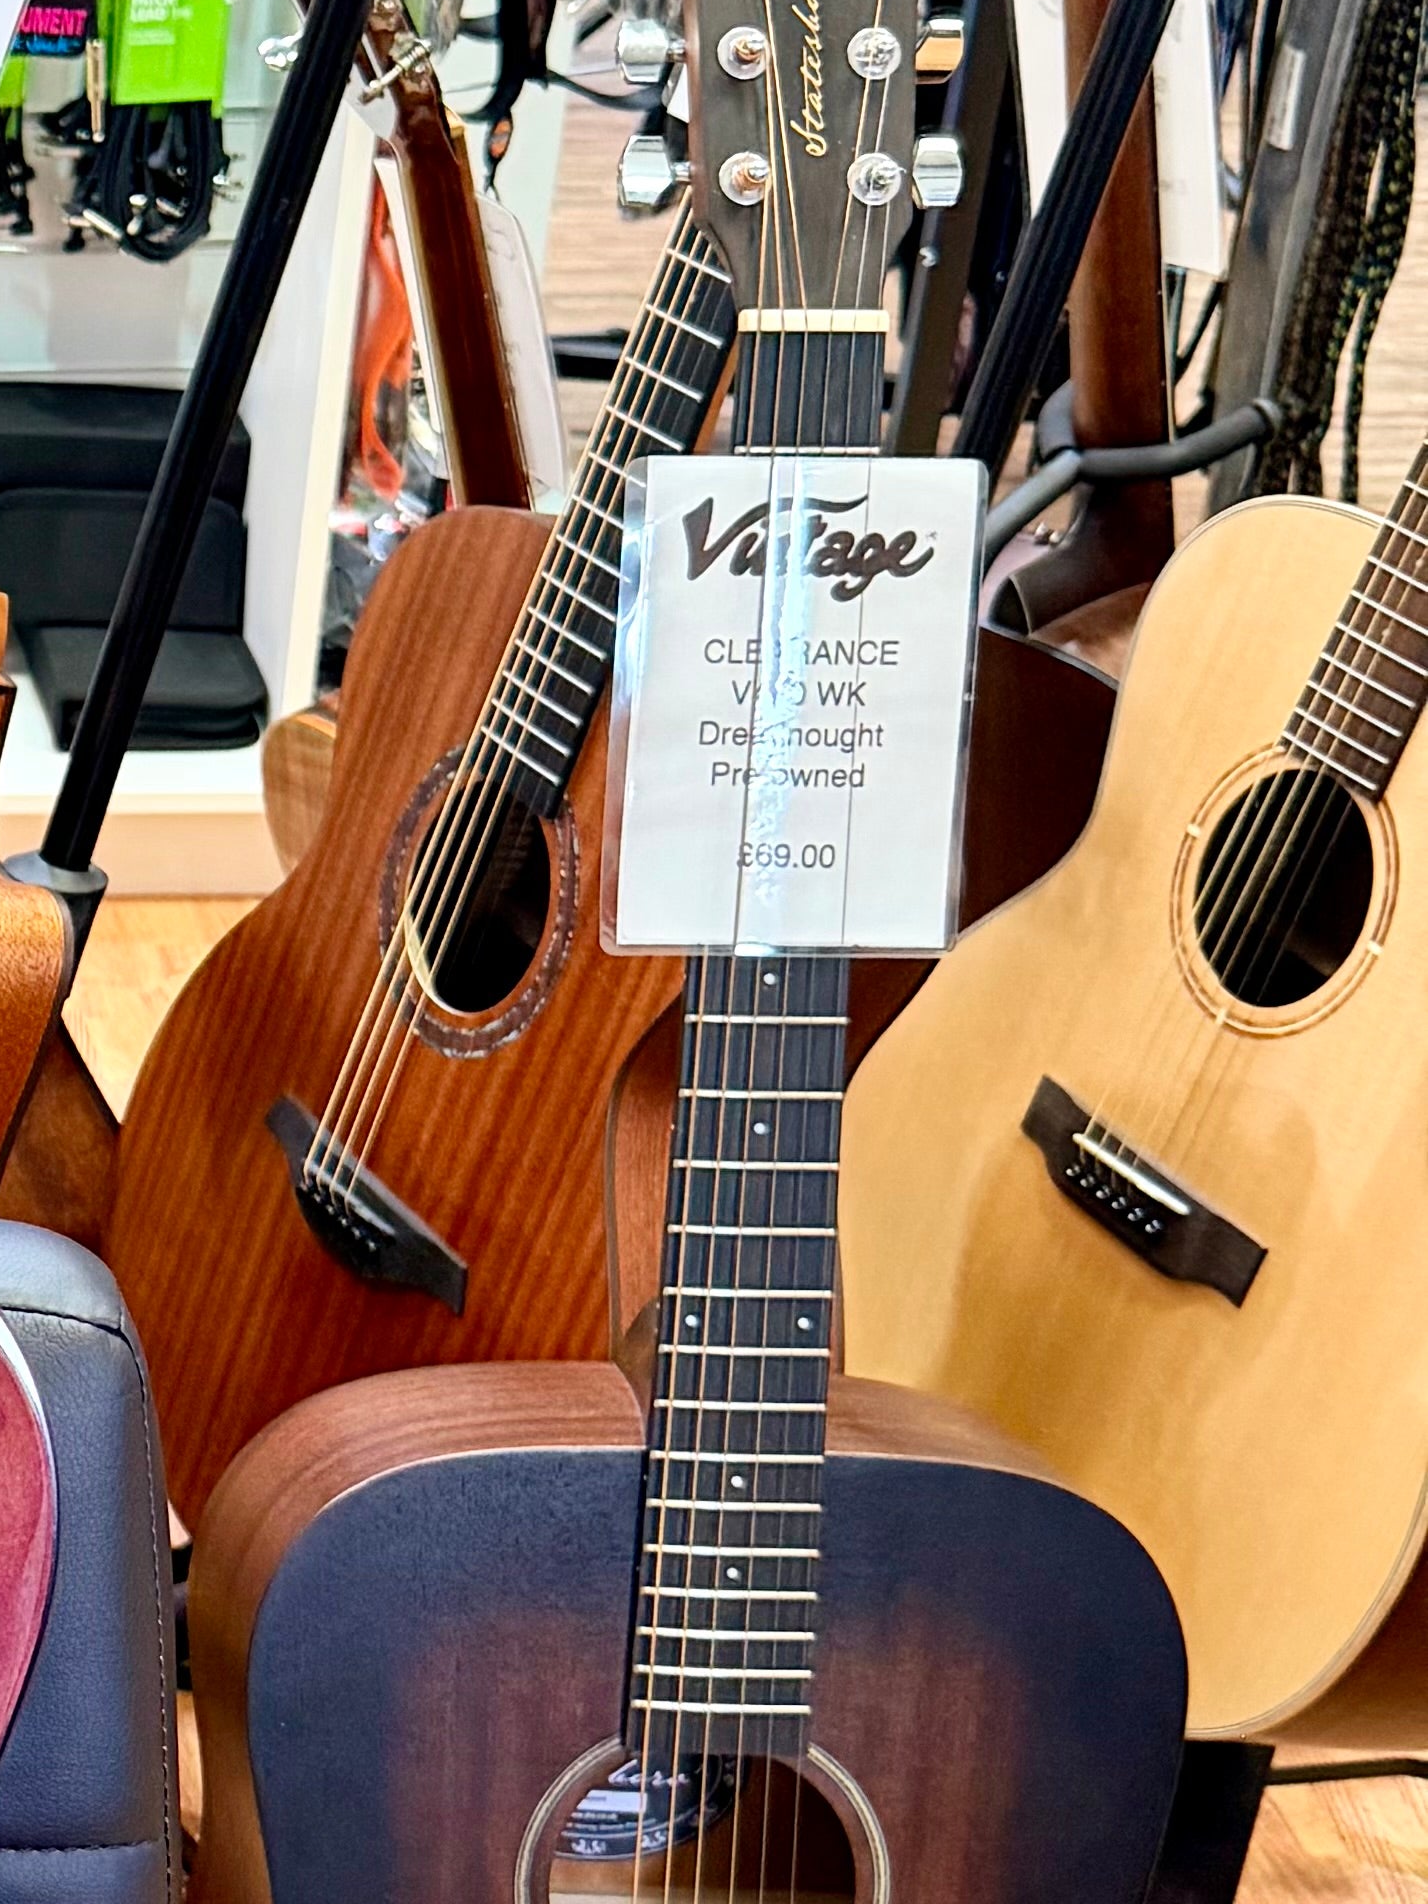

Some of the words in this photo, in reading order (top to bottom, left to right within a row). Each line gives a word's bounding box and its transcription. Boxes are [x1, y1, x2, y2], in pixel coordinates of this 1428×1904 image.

[703, 638, 900, 667] CLEANCE
[817, 680, 867, 707] WK
[699, 720, 885, 752] Drenought
[711, 761, 865, 788] Preowned
[736, 842, 836, 870] £69.00
